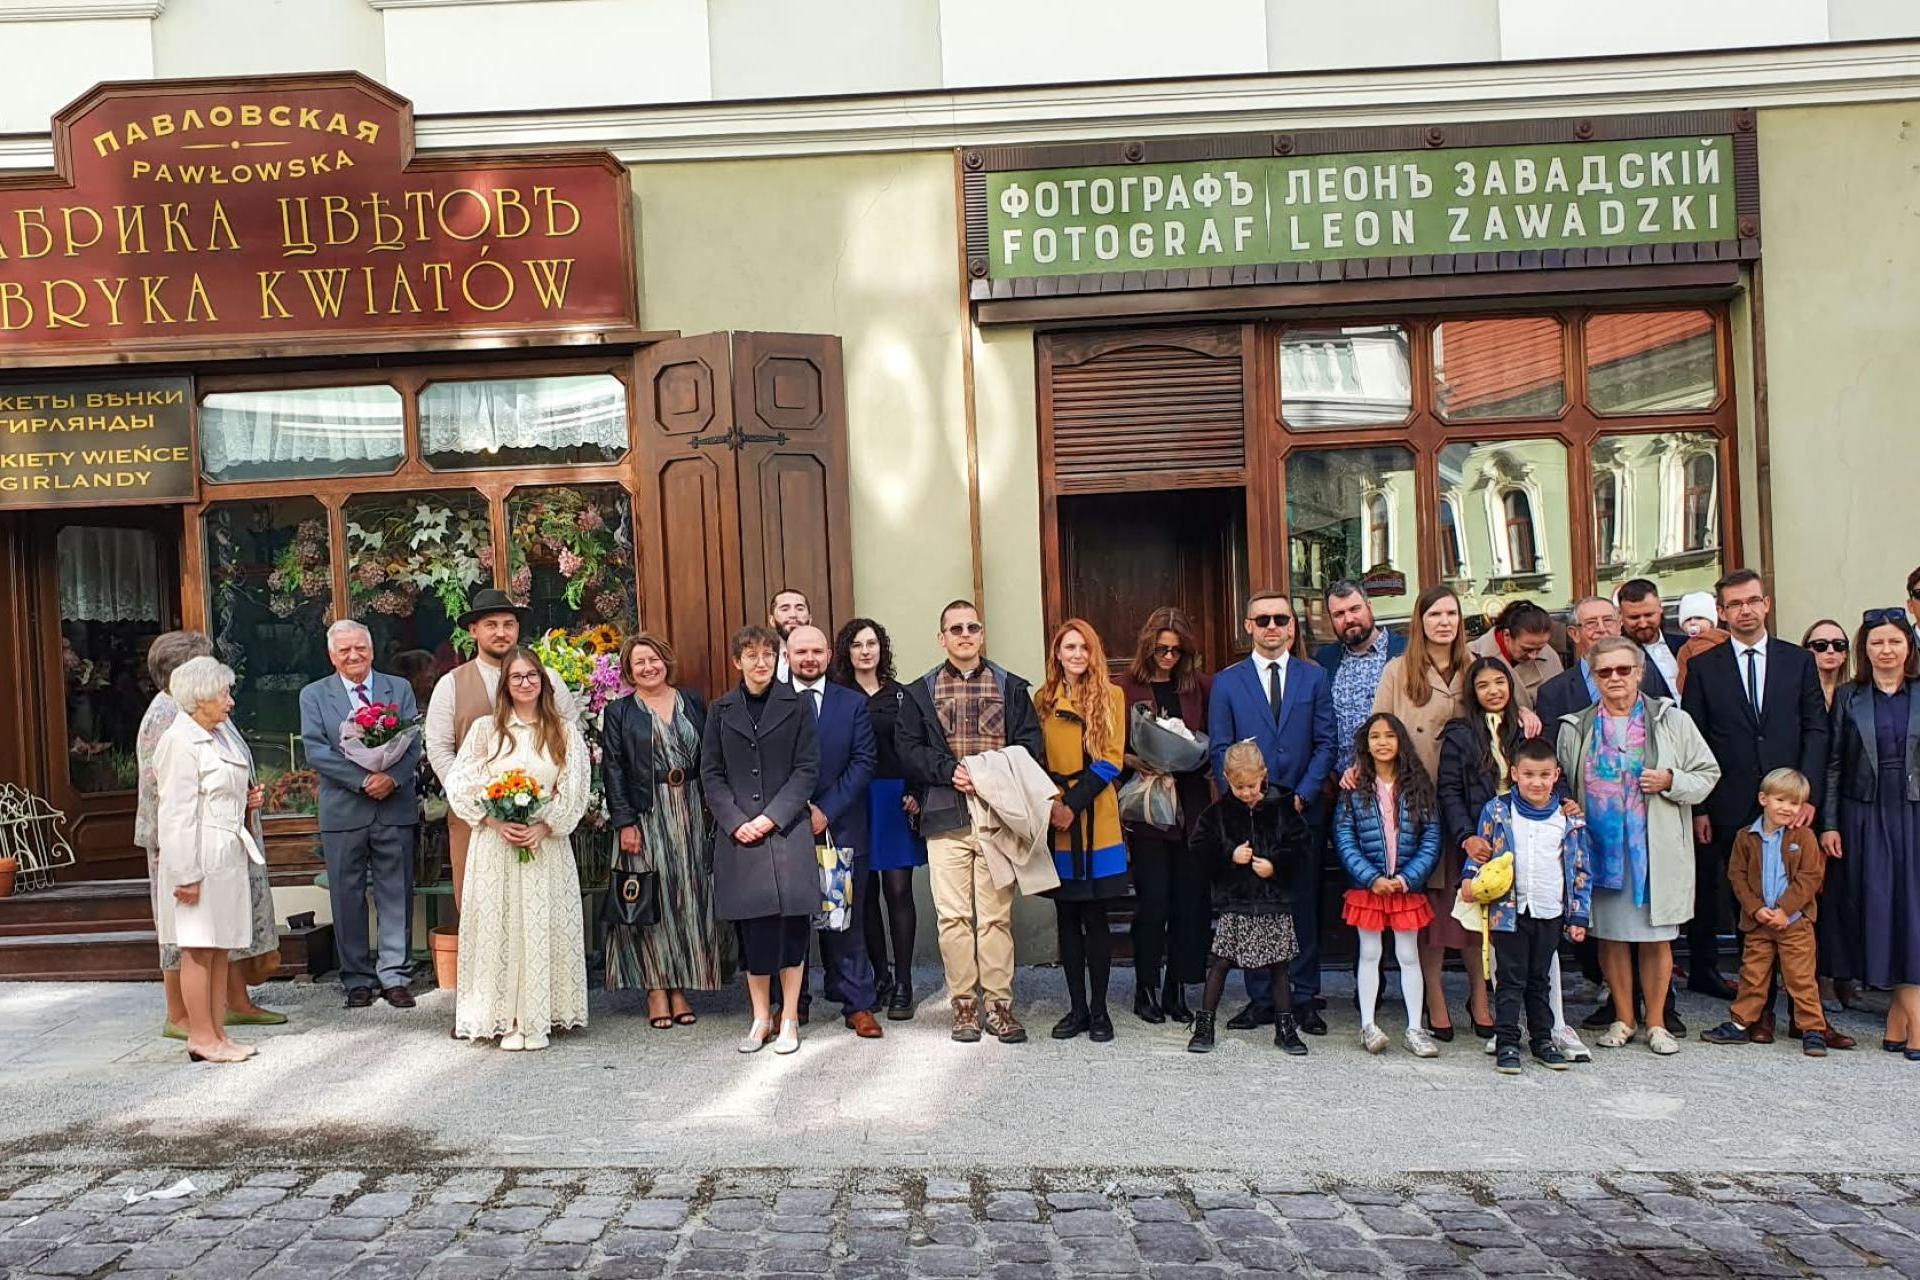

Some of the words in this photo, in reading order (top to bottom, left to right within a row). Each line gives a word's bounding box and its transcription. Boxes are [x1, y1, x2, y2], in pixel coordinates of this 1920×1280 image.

[93, 104, 381, 158] ПАВЛОВСКАЯ
[132, 149, 356, 184] PAWŁOWSKA
[999, 170, 1254, 219] ФОТОГРАФЪ
[1285, 162, 1433, 204] ЛЕОНЪ
[1003, 216, 1254, 265] FOTOGRAF
[1288, 209, 1415, 252] LEON
[1448, 194, 1718, 243] ZAWADZKI
[256, 246, 575, 320] KWIATÓW
[0, 471, 152, 491] GIRLANDY
[82, 444, 189, 465] WIEŃCE
